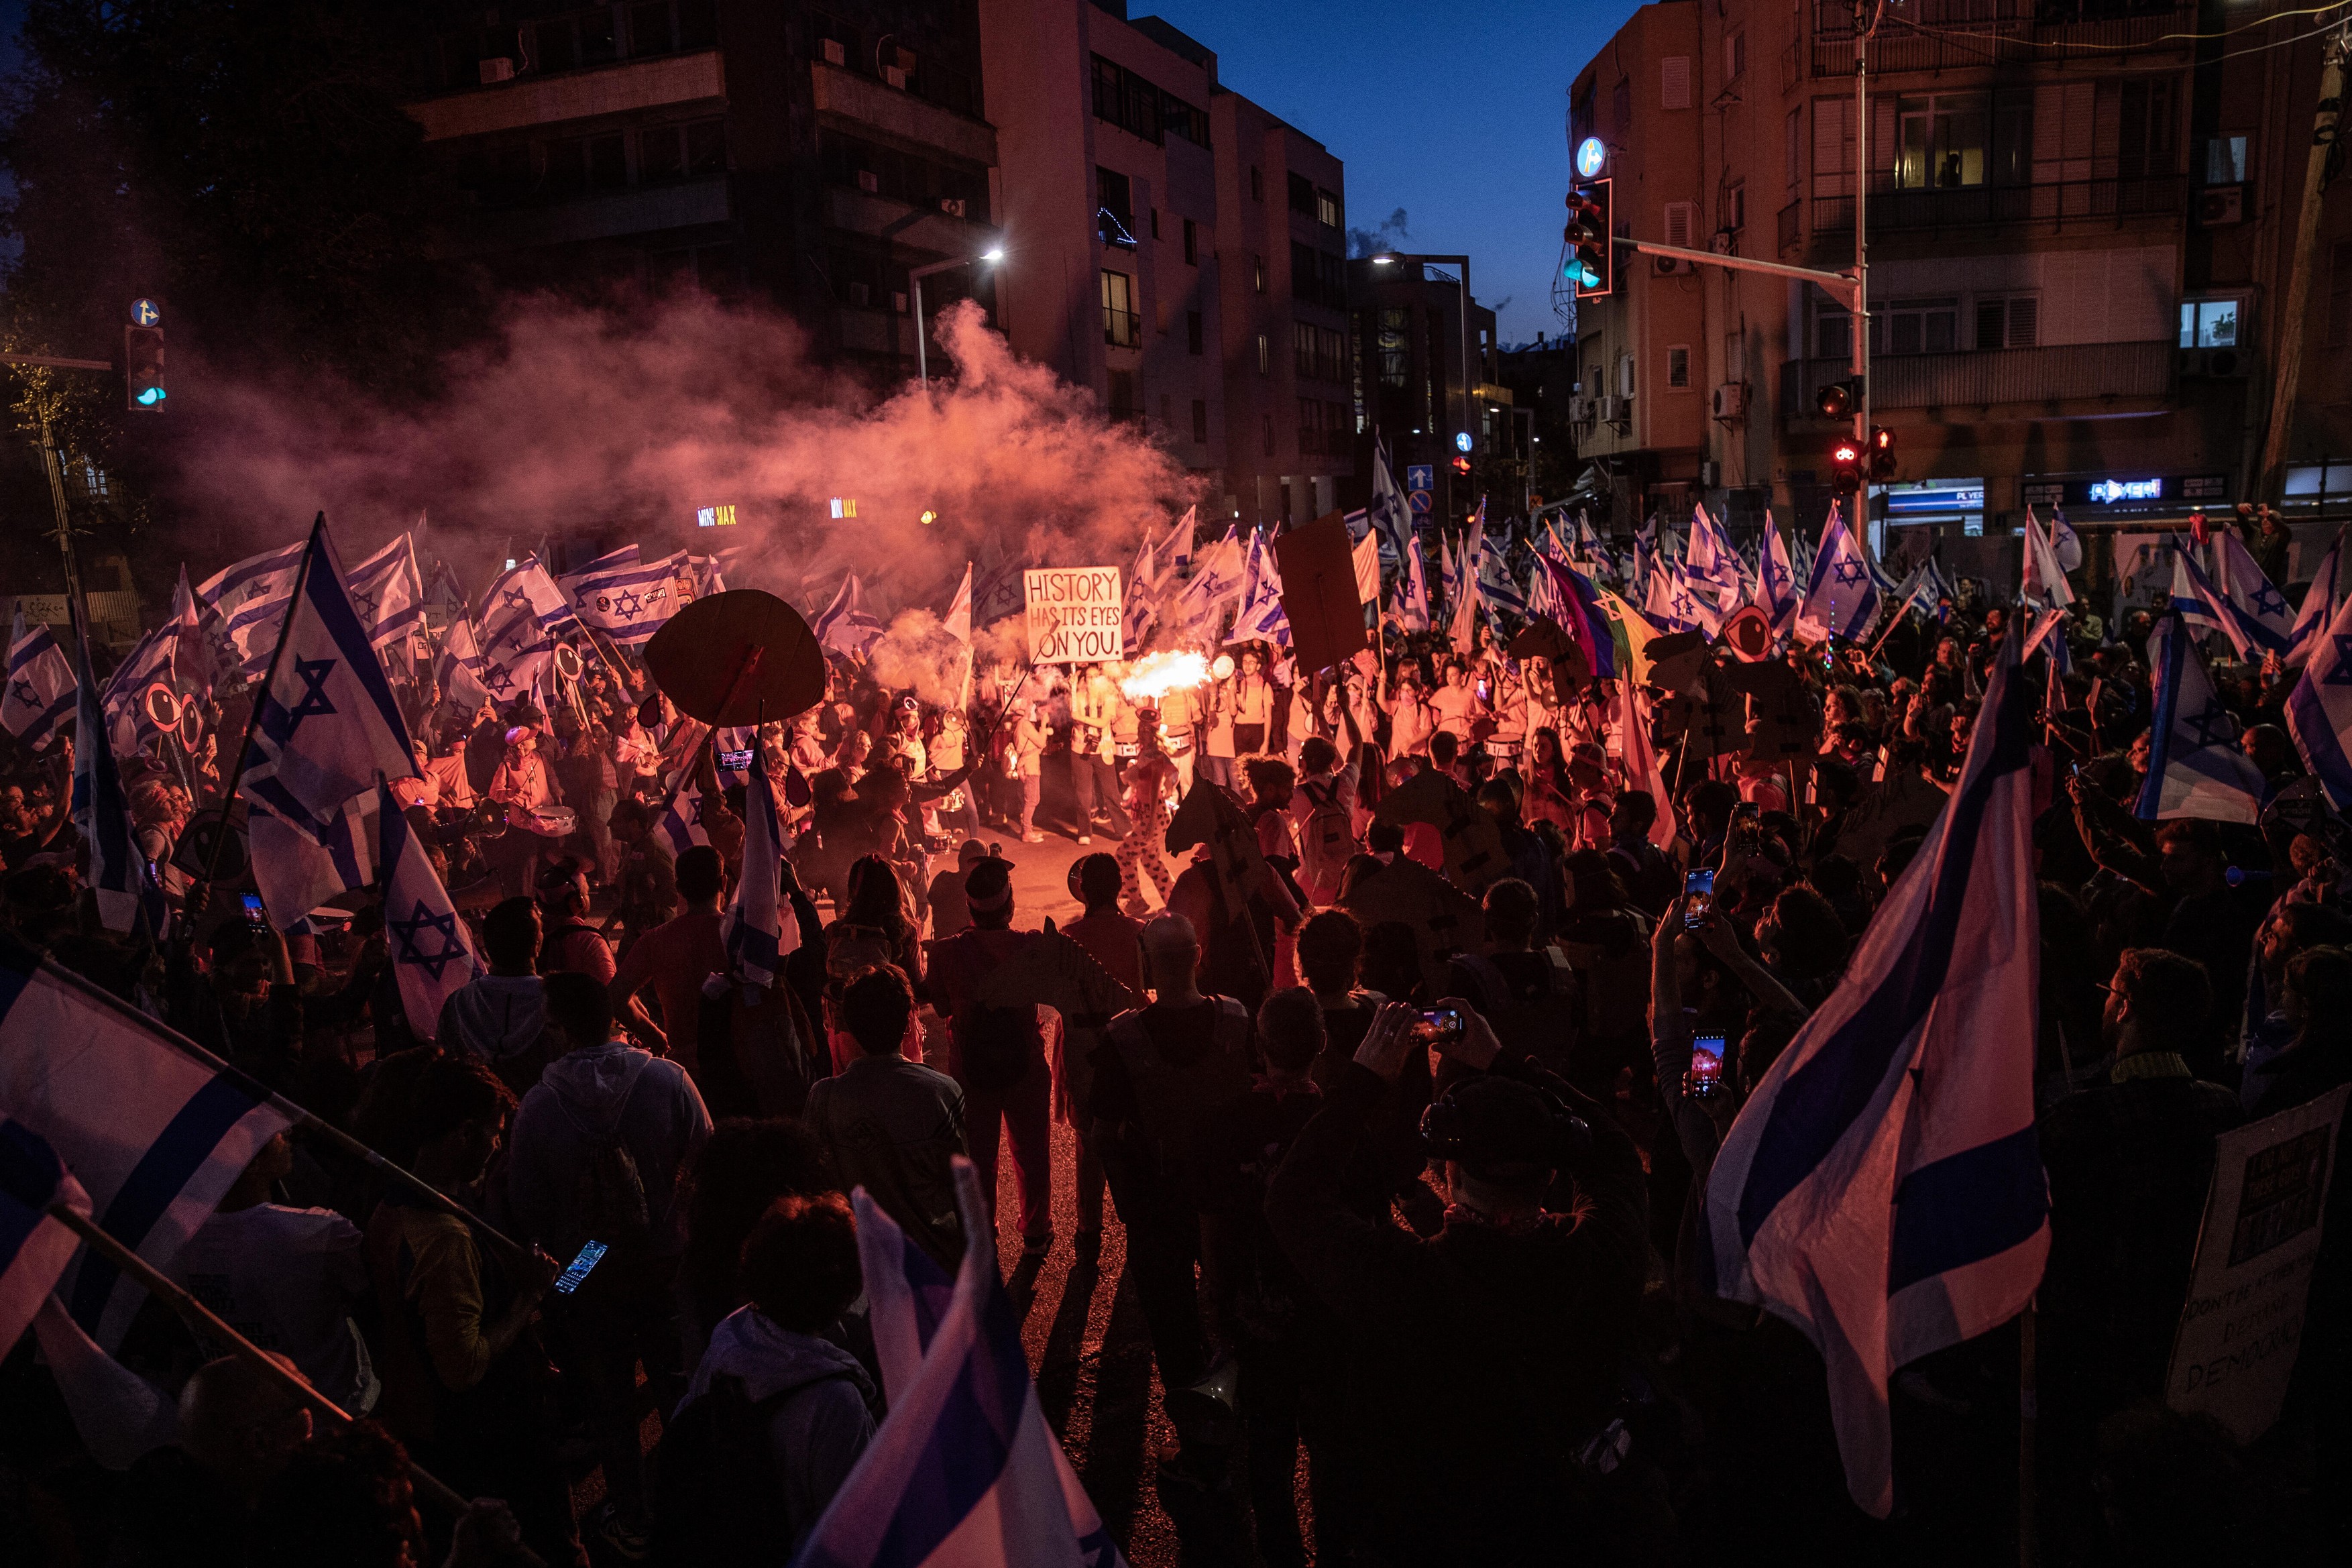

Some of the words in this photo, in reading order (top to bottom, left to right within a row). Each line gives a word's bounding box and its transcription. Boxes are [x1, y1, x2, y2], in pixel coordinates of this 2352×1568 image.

[716, 505, 736, 526] MAX
[843, 498, 857, 518] MAX
[1029, 573, 1117, 602] HISTORY
[1031, 606, 1057, 627] HAS
[1062, 607, 1086, 626] ITS
[1091, 607, 1120, 626] EYES
[1040, 631, 1068, 658] ON
[1073, 631, 1119, 657] YOU.
[2188, 1289, 2235, 1321] DON'T
[2235, 1283, 2251, 1304] BE
[2223, 1292, 2289, 1344] DEMAND
